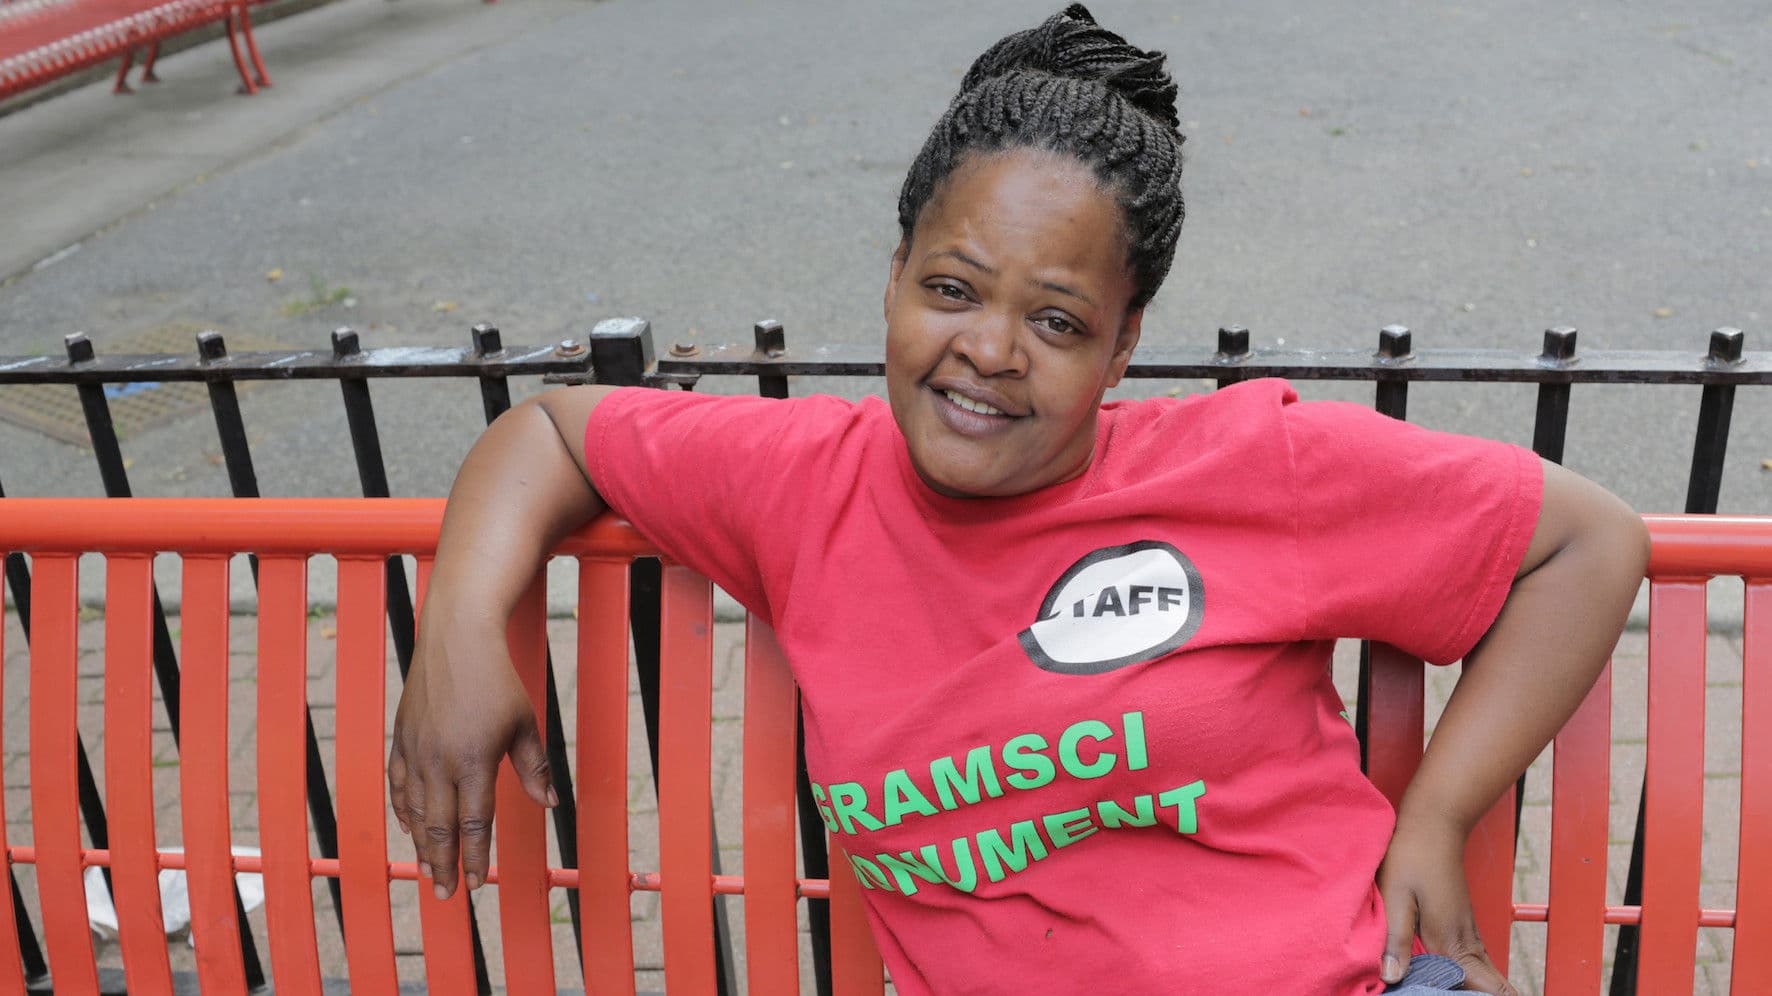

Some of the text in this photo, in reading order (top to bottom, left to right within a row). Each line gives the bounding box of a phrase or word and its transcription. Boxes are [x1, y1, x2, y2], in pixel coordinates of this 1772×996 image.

[1072, 584, 1184, 618] TAFF
[811, 711, 1149, 835] GRAMSCI
[843, 780, 1207, 897] ONUMENT
